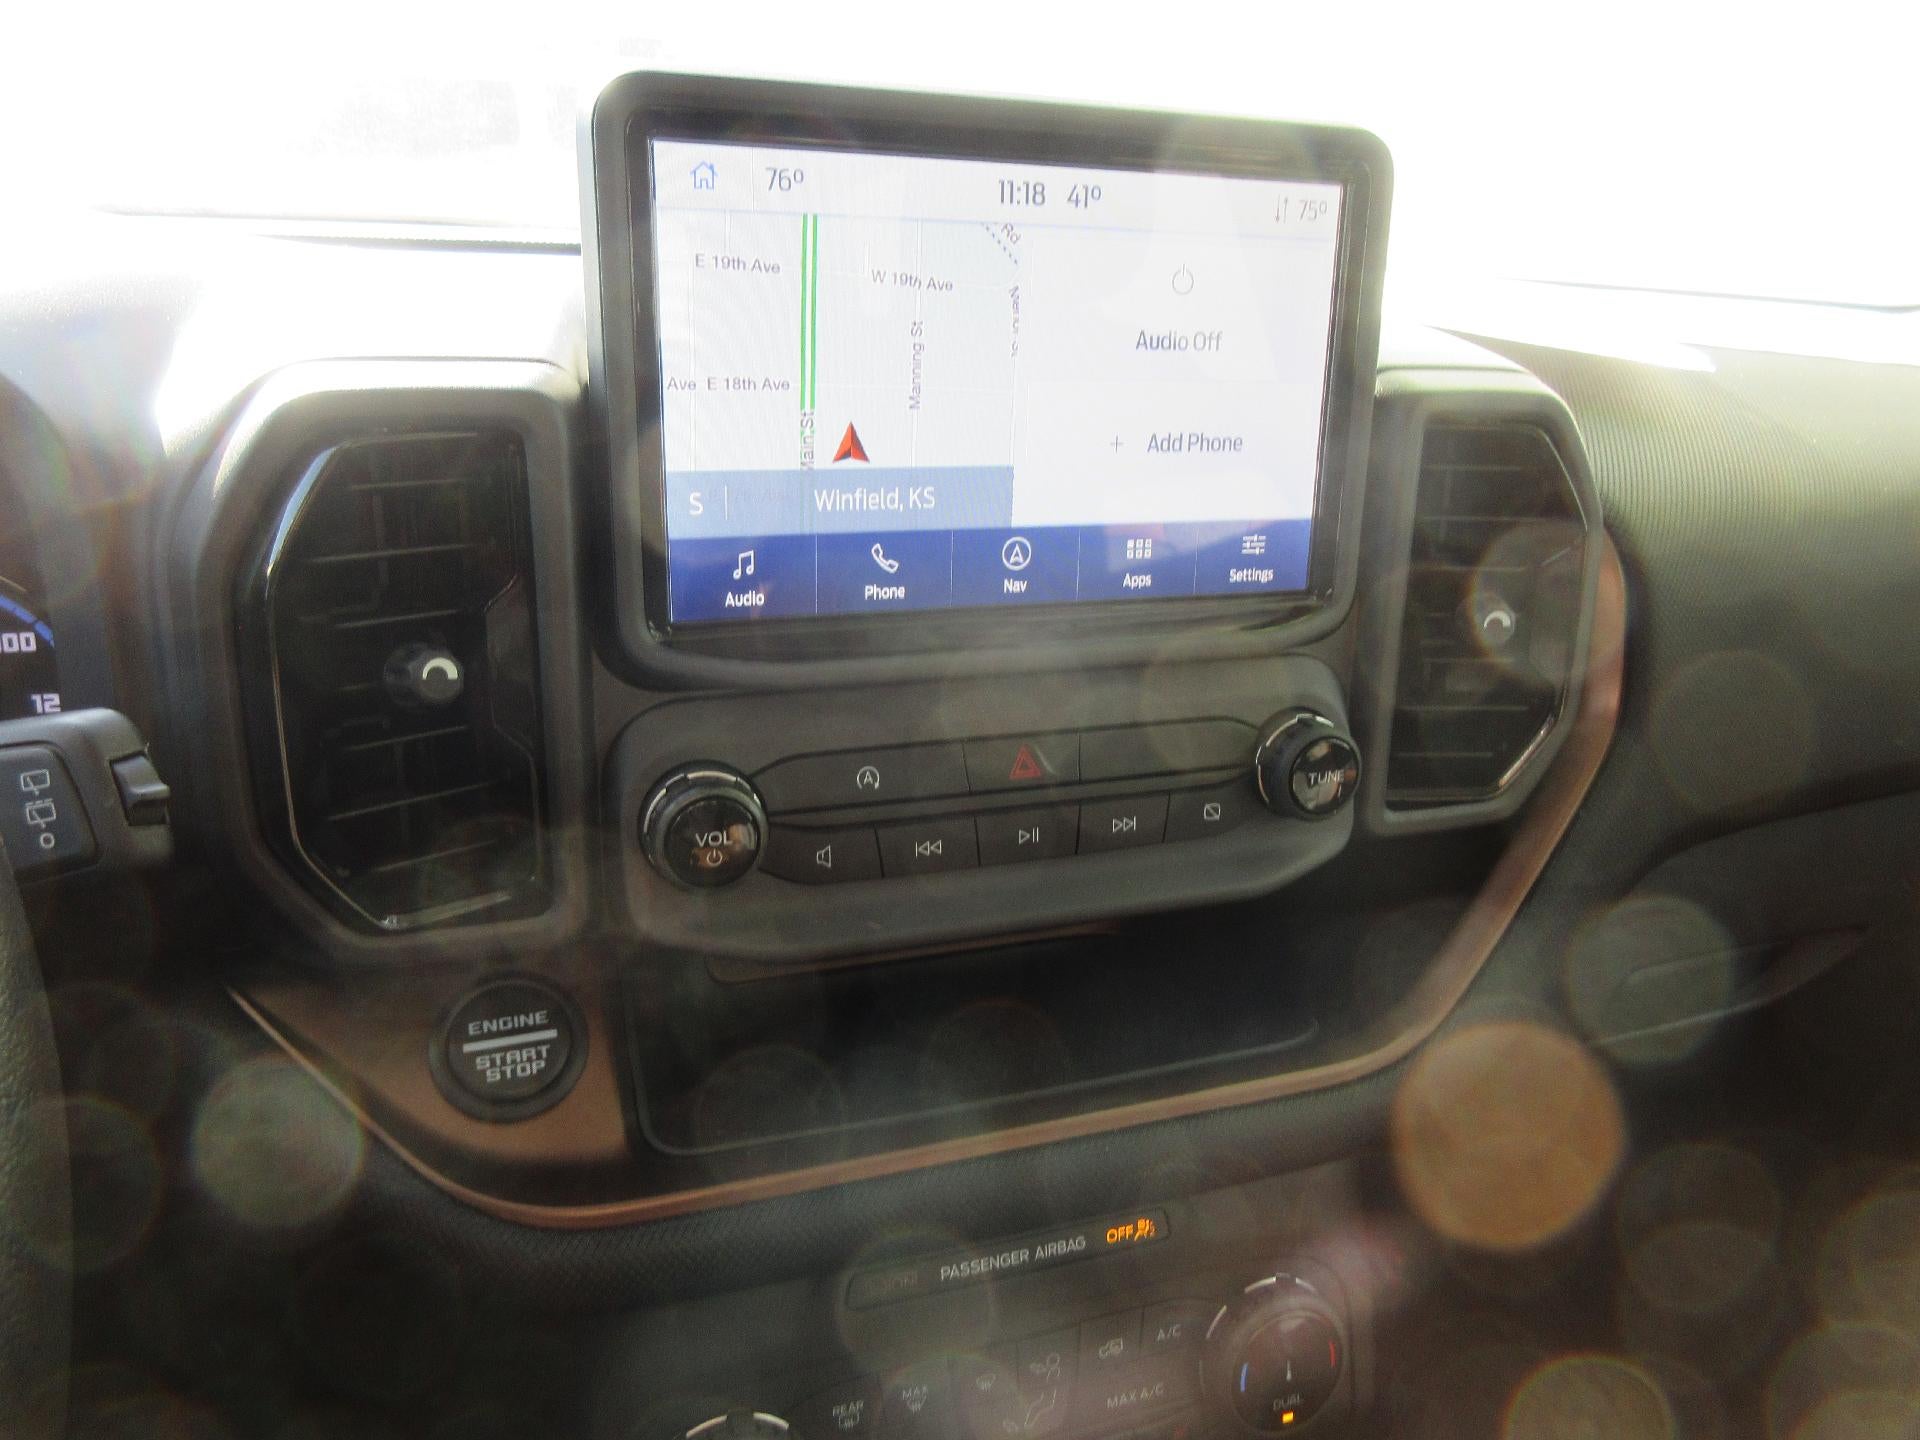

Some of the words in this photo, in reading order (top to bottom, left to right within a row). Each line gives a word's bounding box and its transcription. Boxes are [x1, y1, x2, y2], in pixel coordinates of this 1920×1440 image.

[998, 179, 1046, 207] 11:18
[695, 254, 706, 269] E
[712, 255, 747, 272] 19th
[751, 258, 781, 275] Ave
[871, 269, 887, 284] W
[892, 272, 922, 290] 19th
[926, 276, 954, 292] Ave
[910, 320, 924, 338] St
[1135, 330, 1189, 352] Audio
[1193, 330, 1223, 352] Off
[667, 376, 697, 391] Ave
[706, 376, 718, 391] E
[725, 376, 757, 391] 18th
[761, 376, 790, 391] Ave
[908, 342, 925, 411] Manning
[801, 411, 814, 430] St
[1147, 432, 1183, 453] Add
[1187, 432, 1243, 453] Phone
[688, 492, 704, 516] S
[814, 487, 904, 513] Winfield,
[909, 487, 936, 509] KS
[1123, 573, 1151, 590] Apps
[1229, 567, 1274, 583] Settings
[864, 584, 906, 600] Phone
[1003, 578, 1027, 594] Nav
[725, 591, 765, 608] Audio
[0, 631, 37, 653] 00
[31, 693, 61, 714] 12
[695, 831, 732, 847] VOL
[468, 1010, 550, 1036] ENGINE
[476, 1045, 550, 1070] START
[486, 1060, 546, 1083] STOP
[1106, 1223, 1134, 1245] OFF
[941, 1249, 1030, 1281] PASSENGER
[1035, 1236, 1086, 1261] AIRBAG
